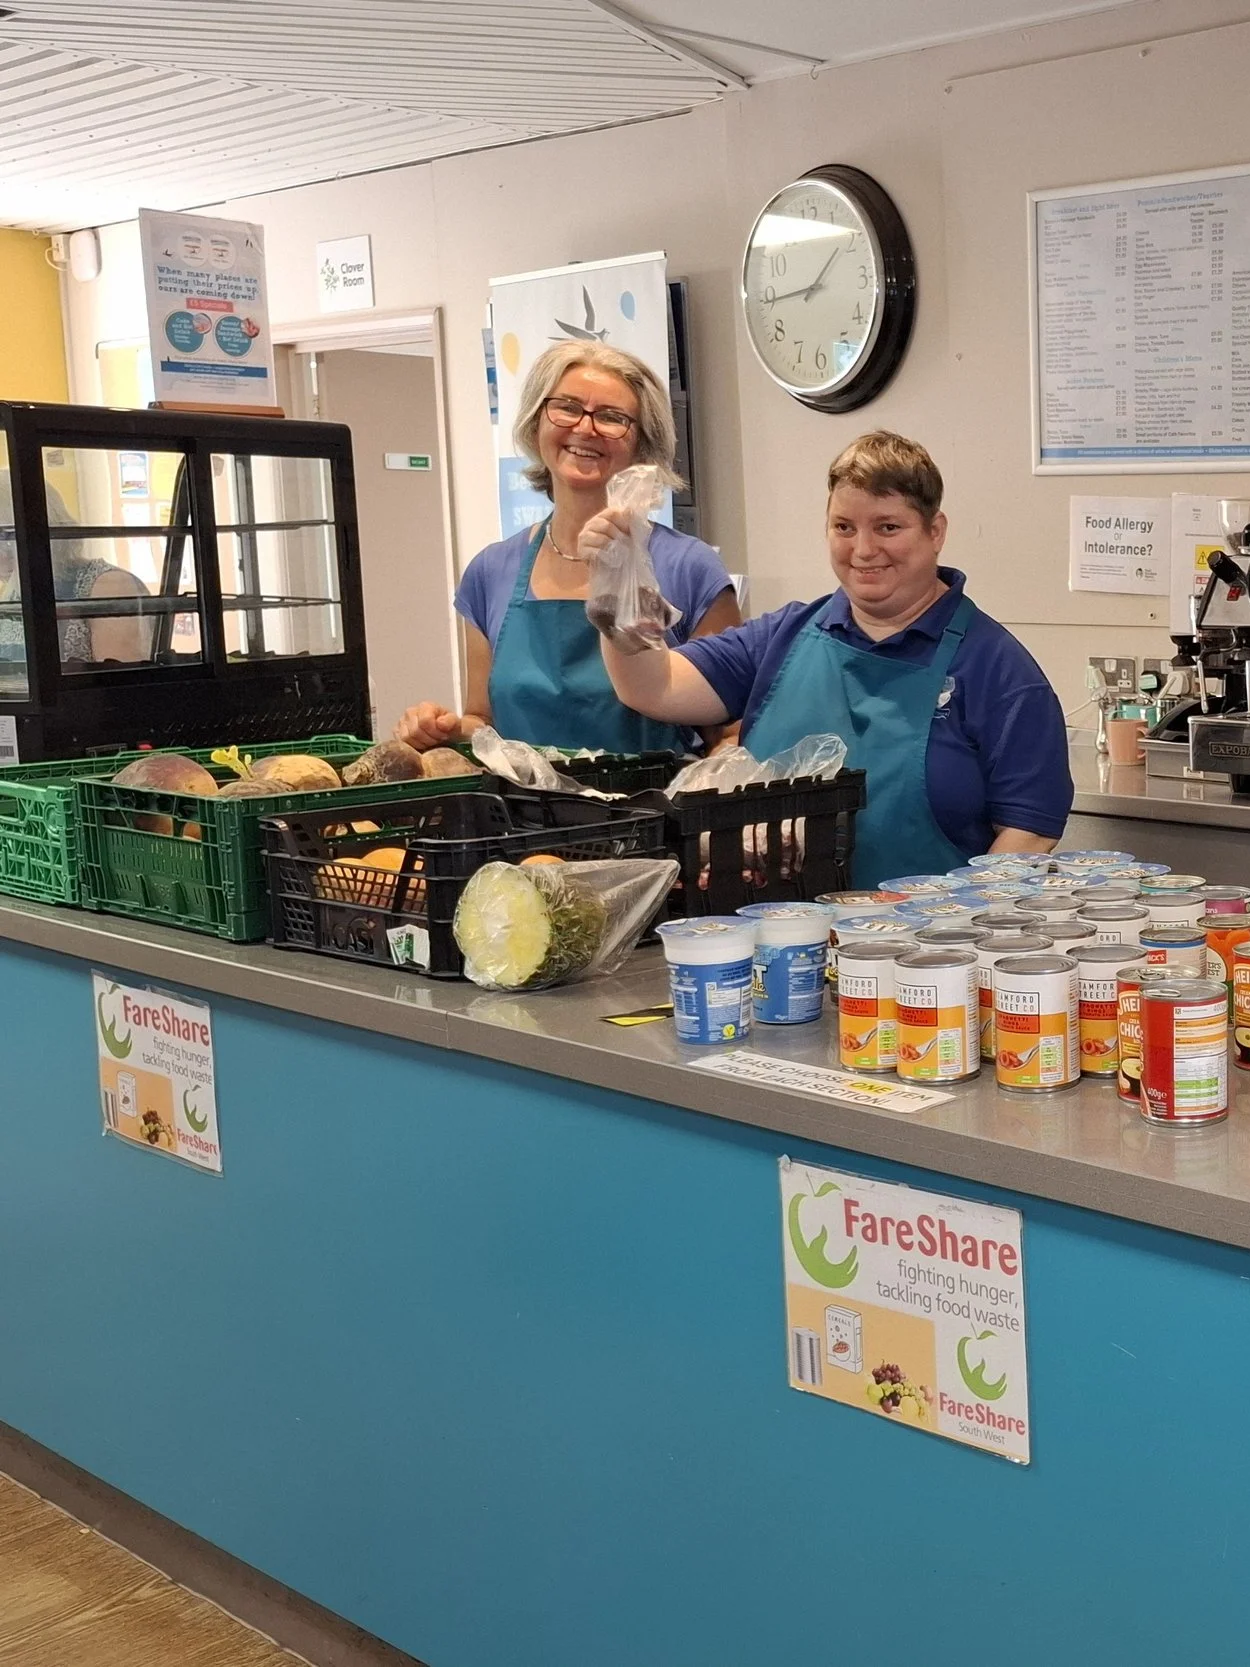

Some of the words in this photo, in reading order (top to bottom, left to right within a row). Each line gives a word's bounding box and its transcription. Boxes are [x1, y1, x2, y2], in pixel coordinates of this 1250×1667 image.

[157, 266, 182, 277] When
[187, 271, 210, 282] many
[215, 273, 241, 284] places
[245, 276, 258, 284] are
[340, 262, 365, 274] Clover
[769, 252, 787, 278] 10
[857, 265, 868, 289] 3
[158, 276, 189, 288] putting
[193, 278, 213, 288] their
[218, 281, 243, 292] prices
[158, 285, 177, 293] ours
[180, 287, 193, 295] are
[197, 289, 228, 300] coming
[343, 275, 365, 287] Room
[765, 286, 776, 312] 9
[852, 301, 864, 325] 4
[774, 319, 786, 342] 8
[794, 341, 804, 363] 7
[815, 344, 827, 370] 6
[1085, 515, 1112, 530] Food
[1113, 517, 1154, 534] Allergy
[1084, 541, 1153, 556] Intolerance?
[1113, 533, 1122, 541] or
[1122, 998, 1140, 1012] HEI
[122, 995, 210, 1047] FareShare
[153, 1036, 180, 1060] fighting
[181, 1050, 213, 1070] hunger,
[142, 1052, 170, 1075] tackling
[171, 1060, 189, 1077] food
[189, 1069, 213, 1085] waste
[720, 1052, 781, 1072] PLEASE
[779, 1067, 851, 1086] CHOOSE
[850, 1081, 892, 1095] ONE
[888, 1090, 934, 1102] ITEM
[714, 1063, 761, 1079] FROM
[760, 1074, 811, 1087] EACH
[808, 1078, 891, 1106] SECTION!
[843, 1199, 1018, 1276] FareShare
[897, 1259, 956, 1294] fighting
[959, 1273, 1019, 1308] hunger,
[876, 1280, 932, 1313] tackling
[935, 1292, 971, 1320] food
[973, 1307, 1020, 1333] waste
[828, 1313, 852, 1327] CEREALS
[939, 1391, 1026, 1436] FareShare
[958, 1421, 983, 1438] South
[983, 1428, 1006, 1445] West
